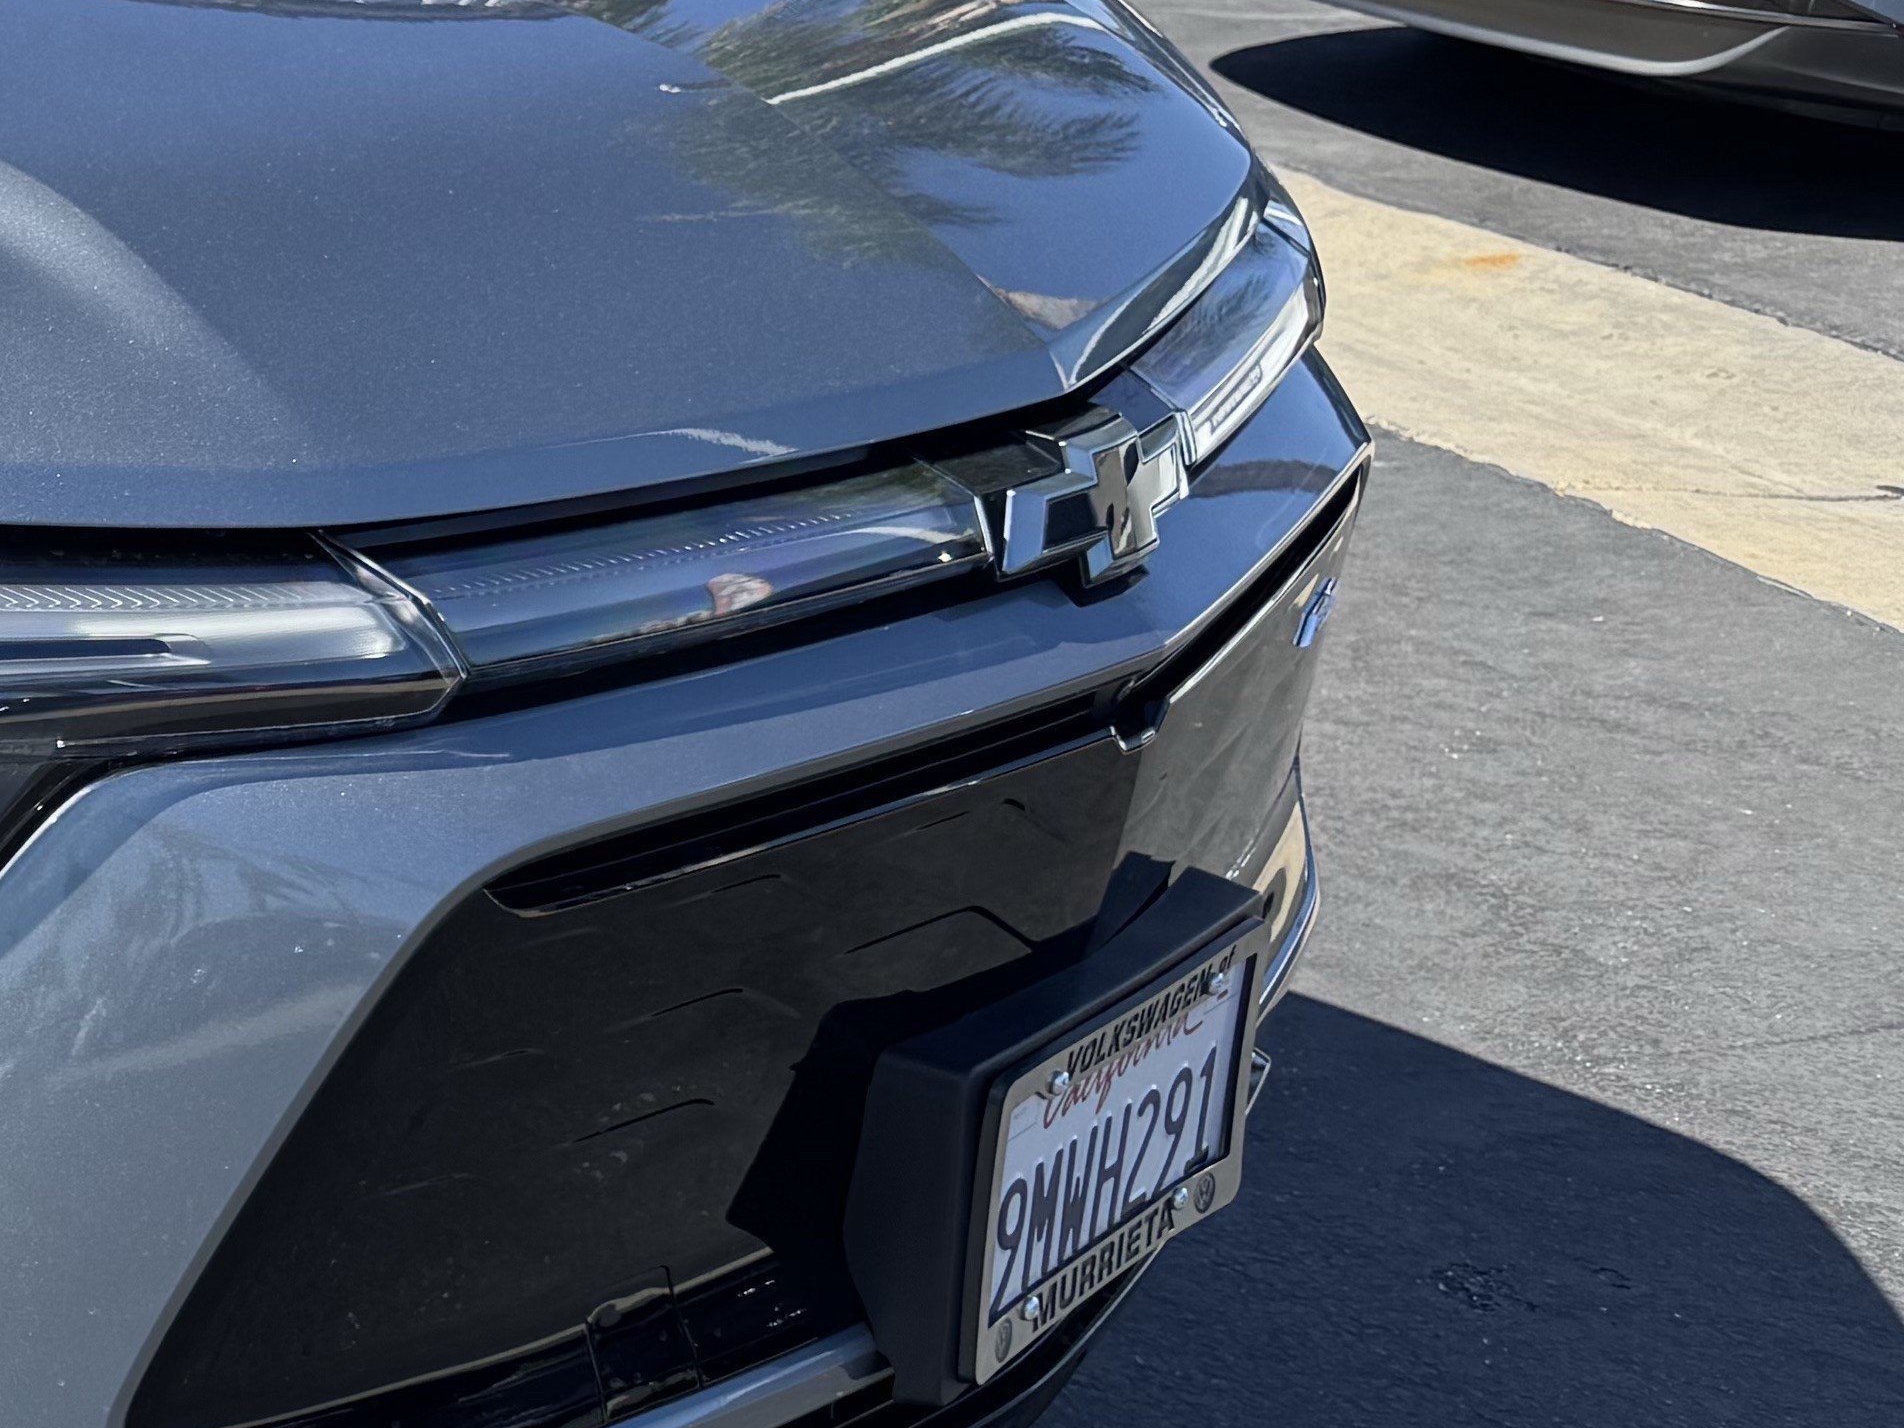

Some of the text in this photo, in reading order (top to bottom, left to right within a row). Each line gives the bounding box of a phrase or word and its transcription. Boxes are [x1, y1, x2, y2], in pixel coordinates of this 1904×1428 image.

[1068, 971, 1214, 1074] VOLKSWAGEN
[989, 1042, 1218, 1328] 9MWH291
[1032, 1201, 1175, 1332] MURRIETA
